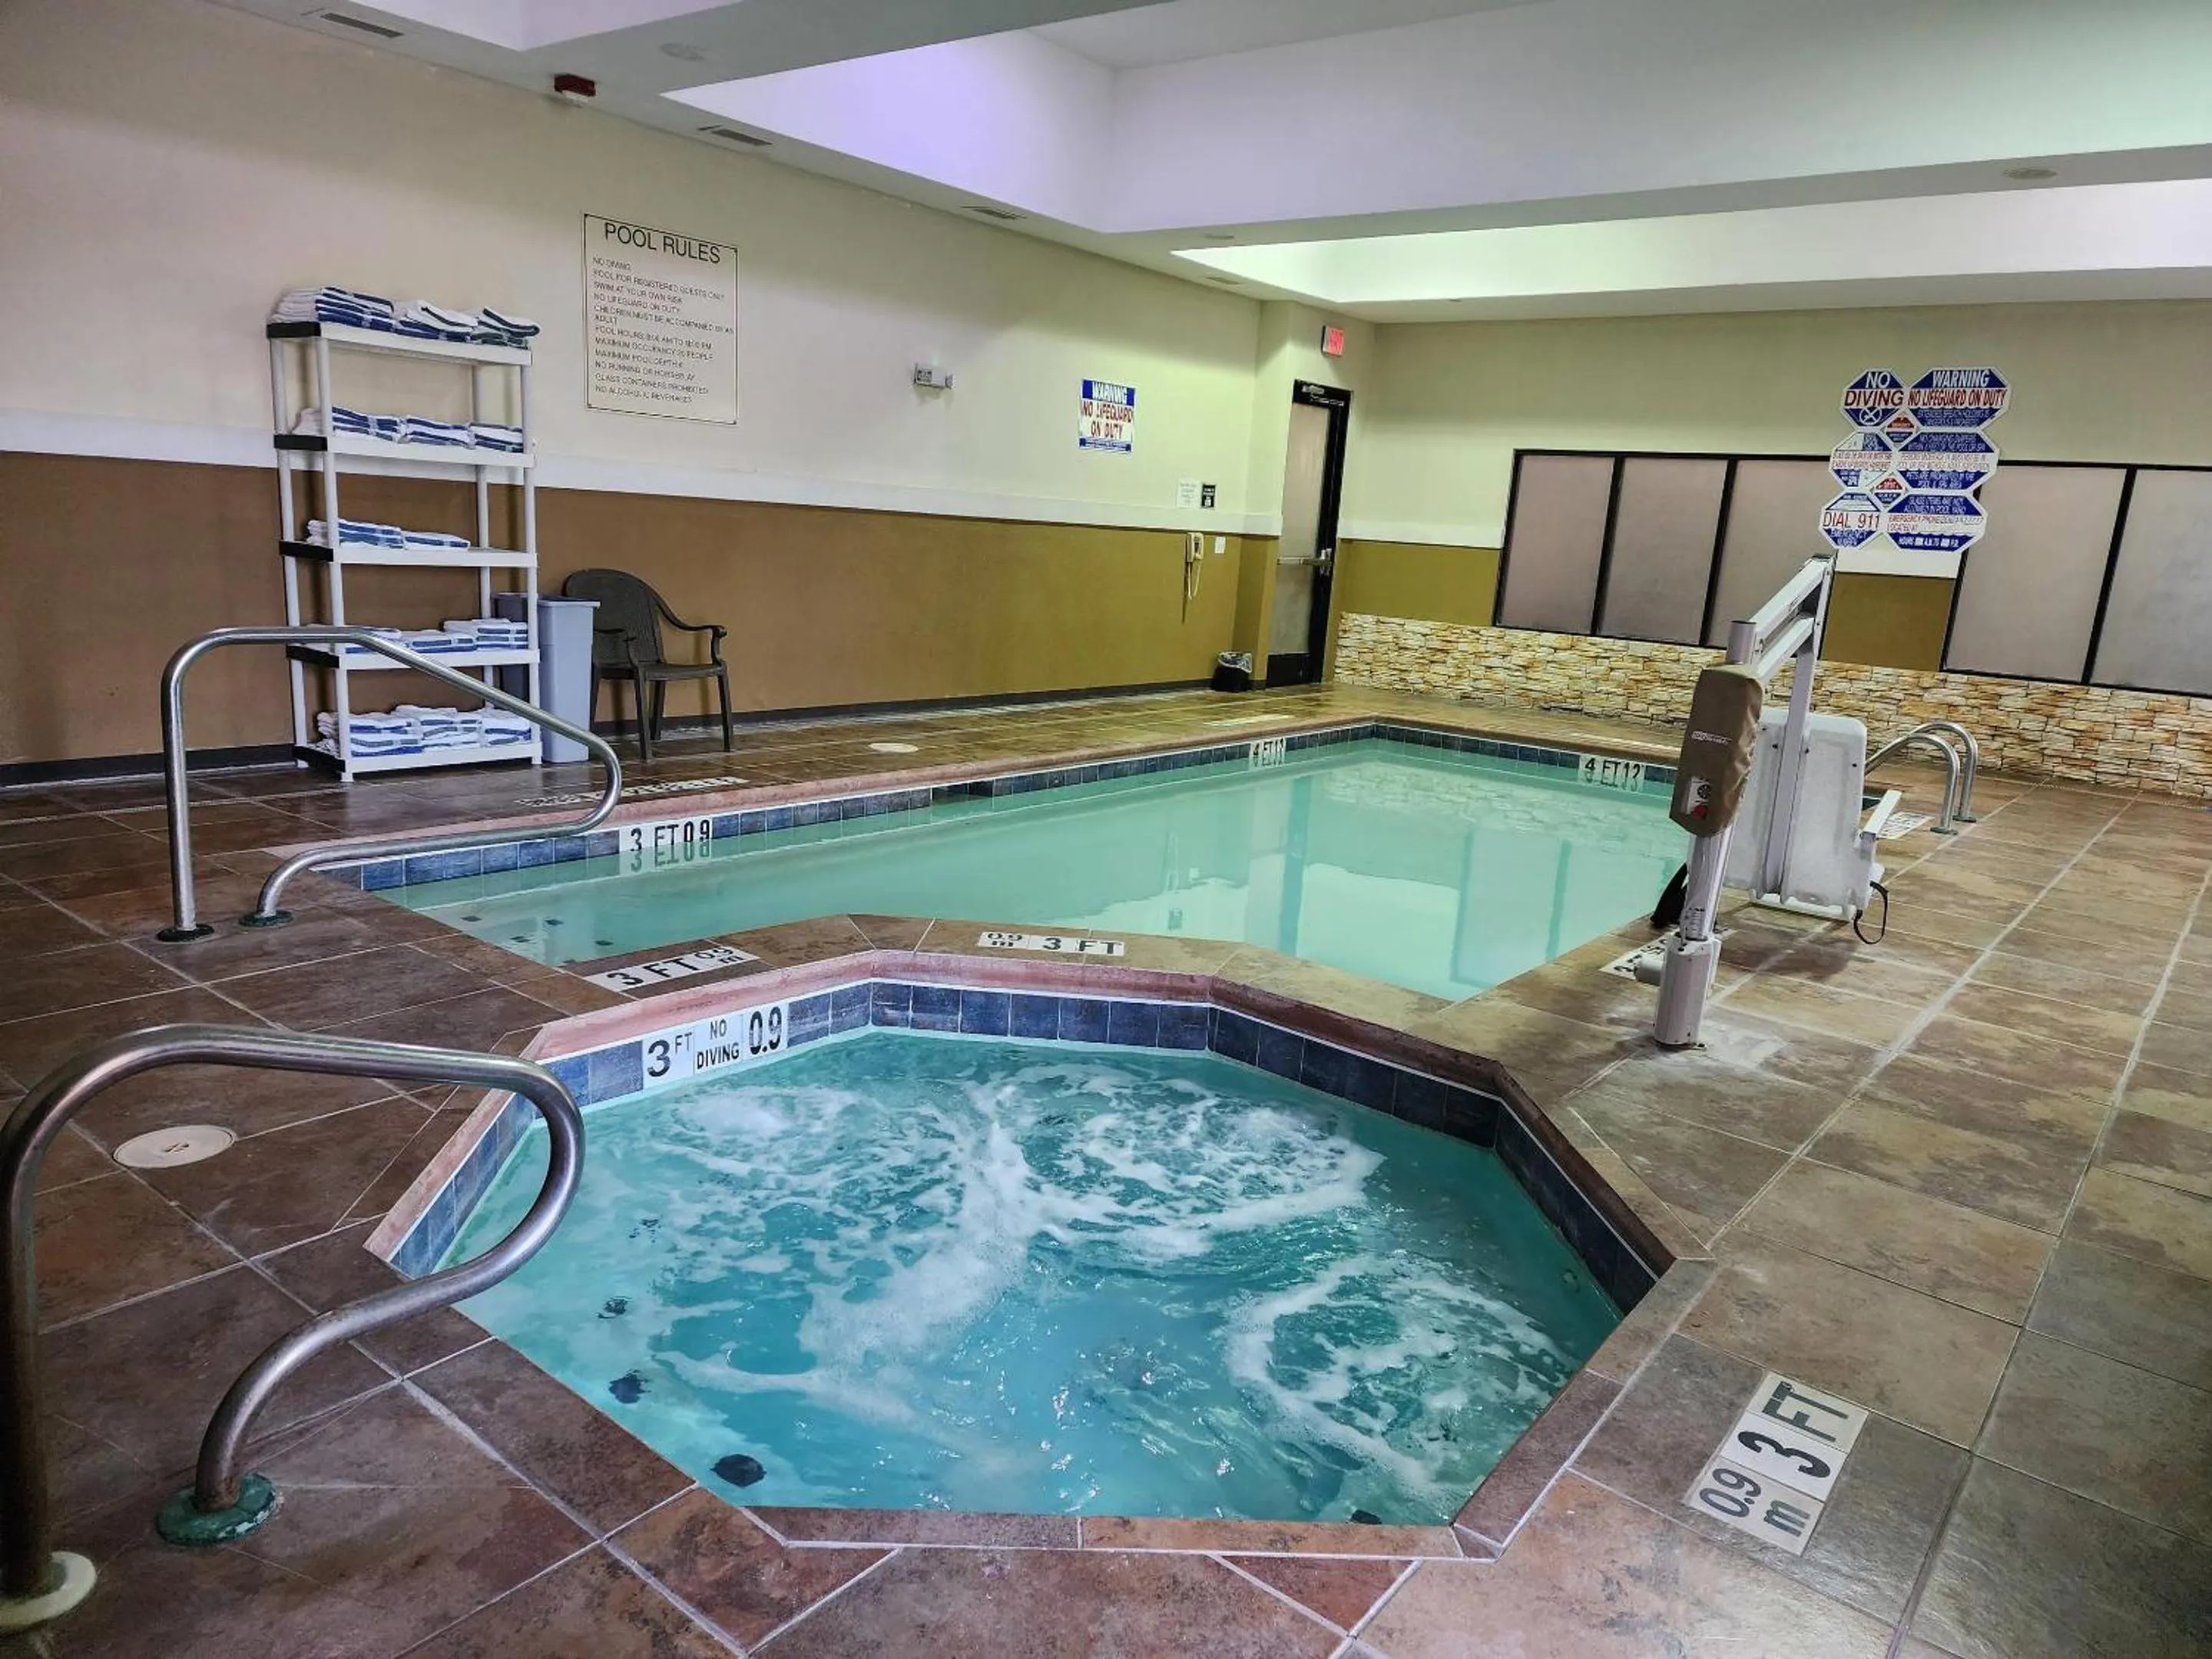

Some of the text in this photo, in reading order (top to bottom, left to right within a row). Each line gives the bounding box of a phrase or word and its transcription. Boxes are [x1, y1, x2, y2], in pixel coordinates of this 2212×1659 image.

[604, 222, 721, 264] POOL RULES
[1866, 371, 1891, 389] NO
[1932, 369, 1991, 389] WARNING
[1092, 381, 1127, 405] WARNING
[1844, 389, 1905, 406] DIVING
[1908, 389, 2007, 406] NO LIFEGUARD ON DUTY
[1083, 400, 1133, 423] NO LIFEGUARD
[1091, 420, 1123, 440] ON DUTY
[1823, 512, 1880, 529] DIAL 911
[1253, 743, 1260, 755] 4
[1585, 758, 1595, 771] 4
[1603, 760, 1621, 775] FT
[630, 827, 642, 852] 3
[655, 824, 679, 848] FT
[1042, 937, 1061, 951] 3
[1078, 940, 1122, 954] FT
[608, 972, 644, 986] 3
[643, 958, 699, 978] FT
[709, 1018, 728, 1040] NO
[647, 1039, 671, 1078] 3
[674, 1032, 692, 1054] FT
[696, 1041, 740, 1069] DIVING
[1738, 1381, 1849, 1478] 3 FT
[1699, 1468, 1811, 1537] 0.9 m
